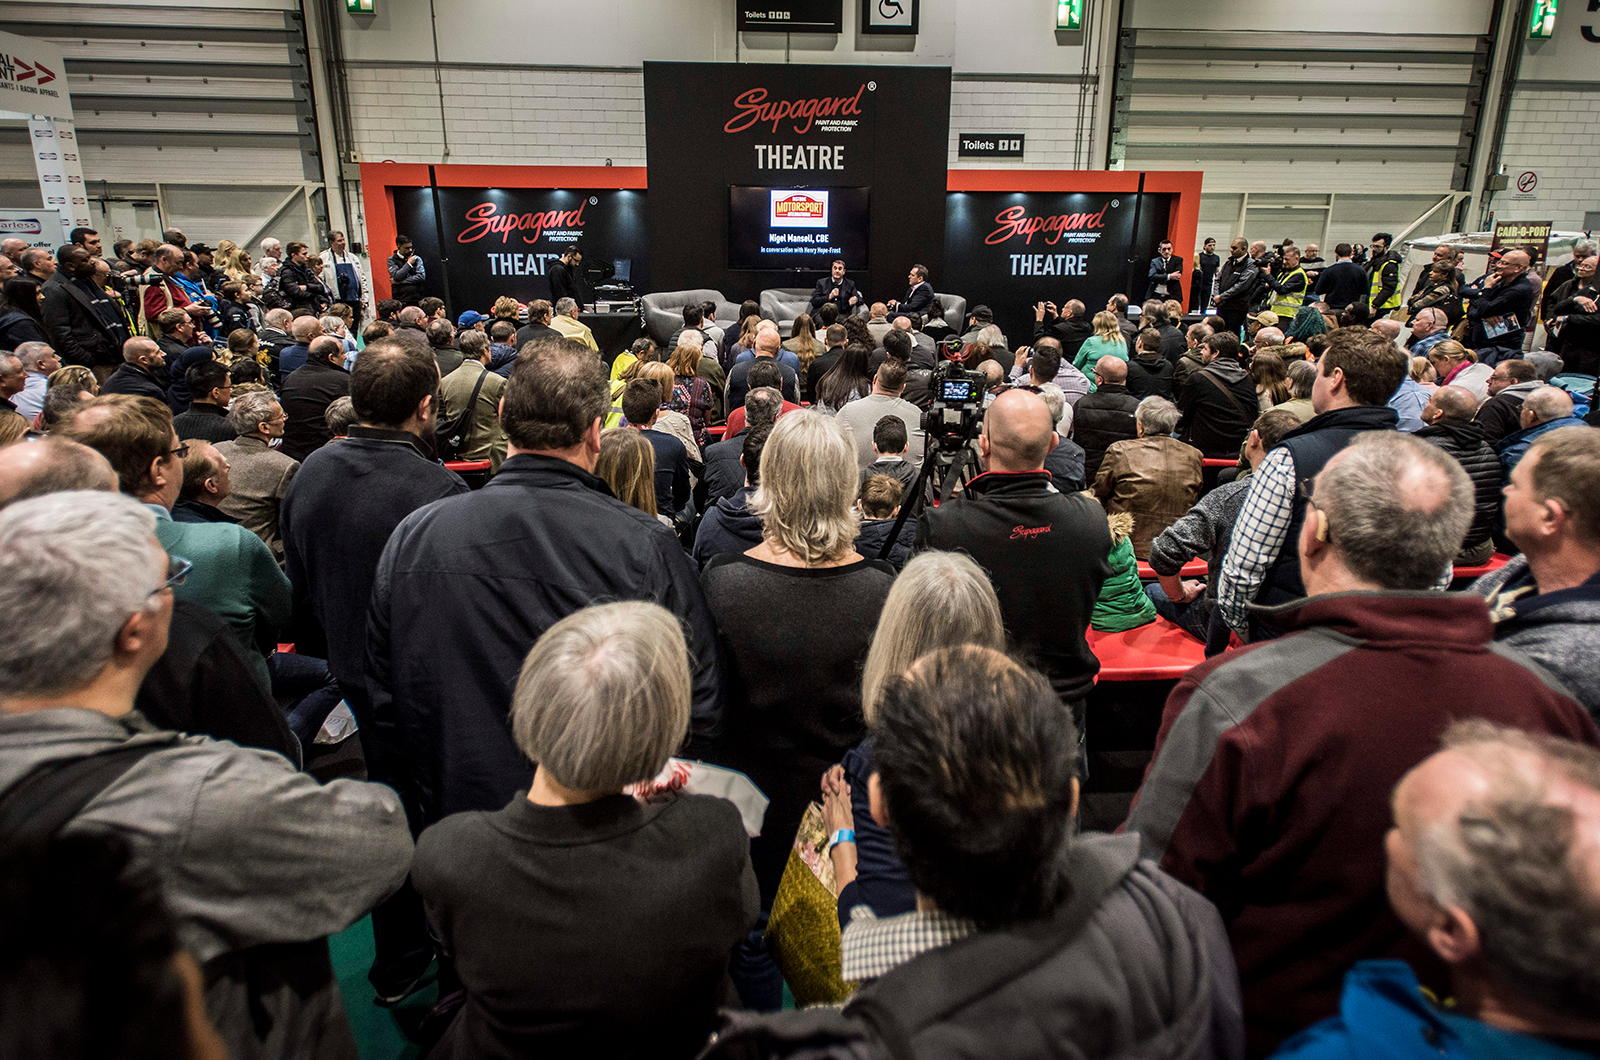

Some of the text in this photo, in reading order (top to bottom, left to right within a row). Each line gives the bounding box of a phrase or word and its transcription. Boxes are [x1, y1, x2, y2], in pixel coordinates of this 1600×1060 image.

[745, 11, 766, 19] Toilets
[20, 85, 38, 94] RACING
[40, 89, 60, 98] APPAREL
[723, 83, 866, 135] Supagard
[963, 140, 995, 150] Toilets
[754, 144, 845, 170] THEATRE
[776, 201, 823, 214] MOTORSPORT
[457, 199, 587, 244] Supagard
[984, 201, 1110, 245] Supagard
[769, 233, 829, 244] Nigel Mansell, CBE
[1496, 226, 1551, 238] CAIR-O-PORT
[804, 246, 817, 255] Henry
[817, 246, 841, 255] Hope-Frost
[487, 252, 566, 276] THEAT
[1009, 254, 1088, 276] THEATRE
[1009, 522, 1052, 539] Supagard
